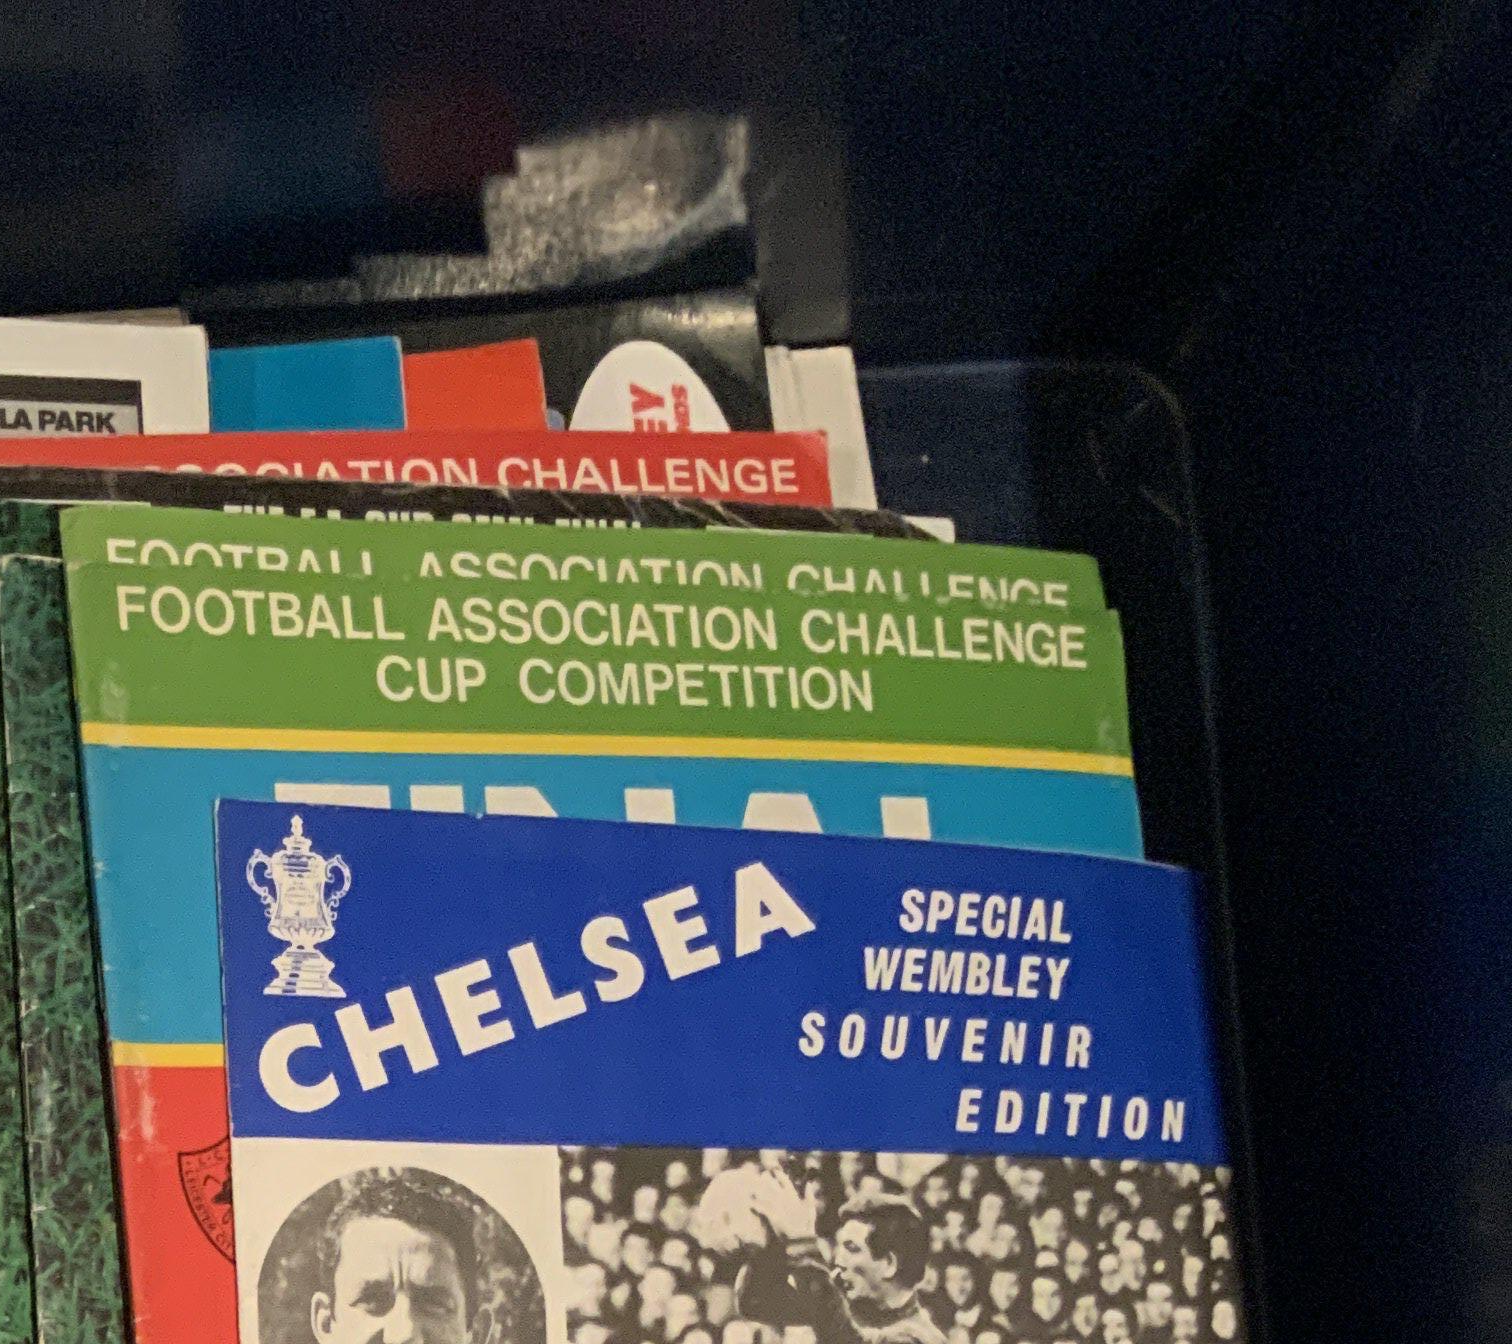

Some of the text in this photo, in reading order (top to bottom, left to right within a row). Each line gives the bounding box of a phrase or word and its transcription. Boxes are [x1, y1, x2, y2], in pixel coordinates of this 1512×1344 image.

[34, 410, 118, 436] PARK
[499, 458, 798, 493] CHALLENGE
[117, 586, 1089, 670] FOOTBALL ASSOCIATION CHALLENGE
[377, 656, 876, 712] CUP COMPETITION
[899, 889, 1072, 944] SPECIAL
[257, 861, 815, 1113] CHELSEA
[863, 945, 1072, 1000] WEMBLEY
[798, 1010, 1092, 1068] SOUVENIR
[955, 1088, 1186, 1143] EDITION
